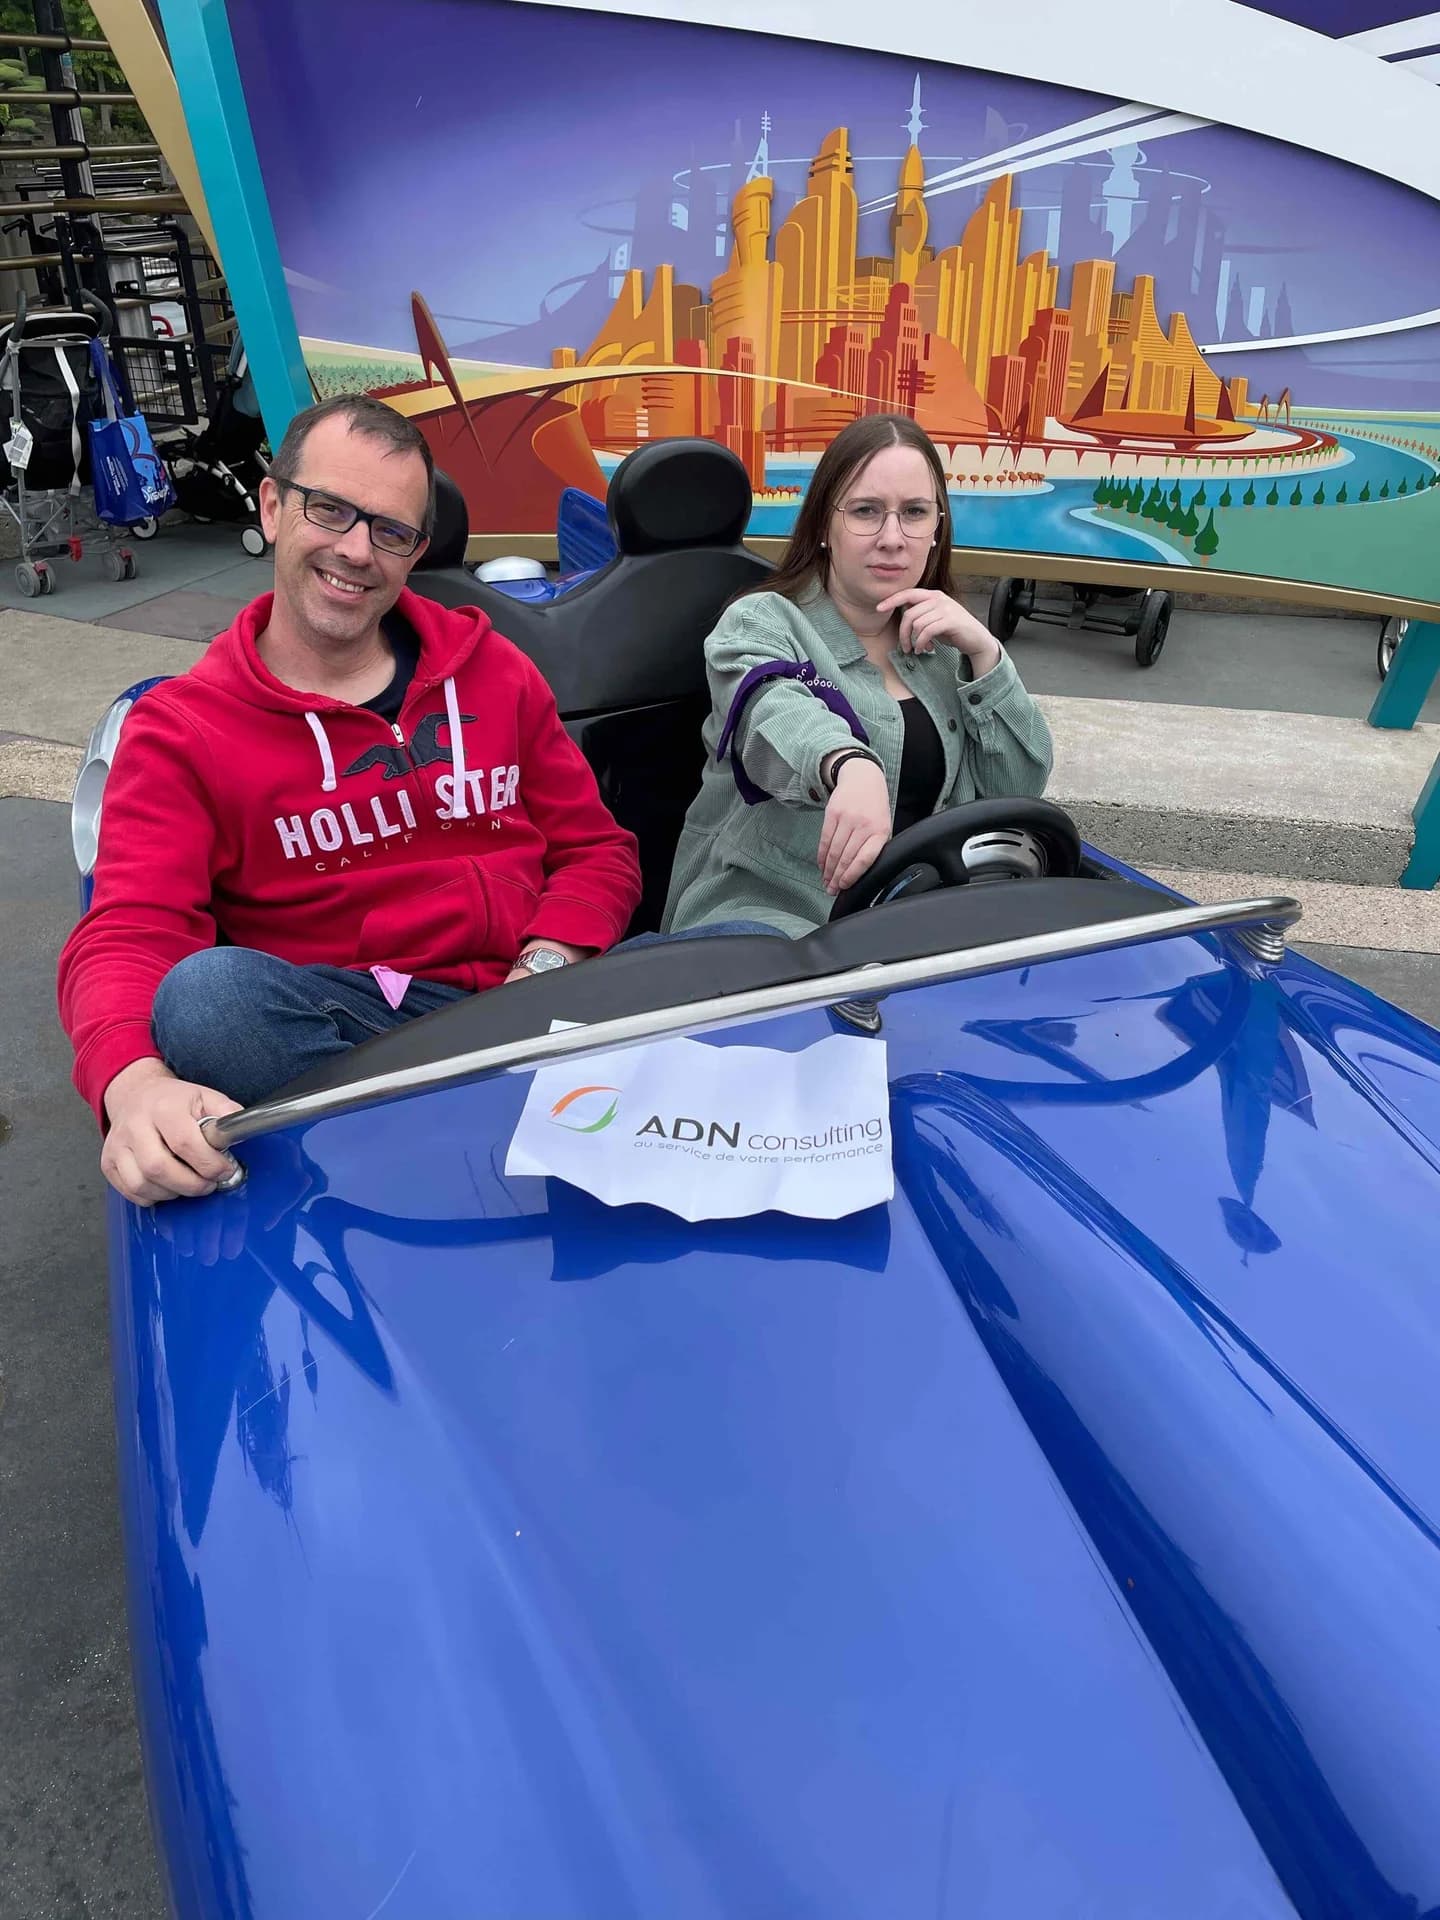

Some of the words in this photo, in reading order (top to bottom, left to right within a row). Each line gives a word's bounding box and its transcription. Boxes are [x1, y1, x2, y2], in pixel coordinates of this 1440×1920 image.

[635, 1115, 741, 1148] ADN
[747, 1117, 884, 1151] consulting
[633, 1140, 653, 1149] au
[657, 1142, 711, 1160] service
[715, 1152, 735, 1162] de
[739, 1154, 779, 1164] votre
[783, 1143, 884, 1164] performance
